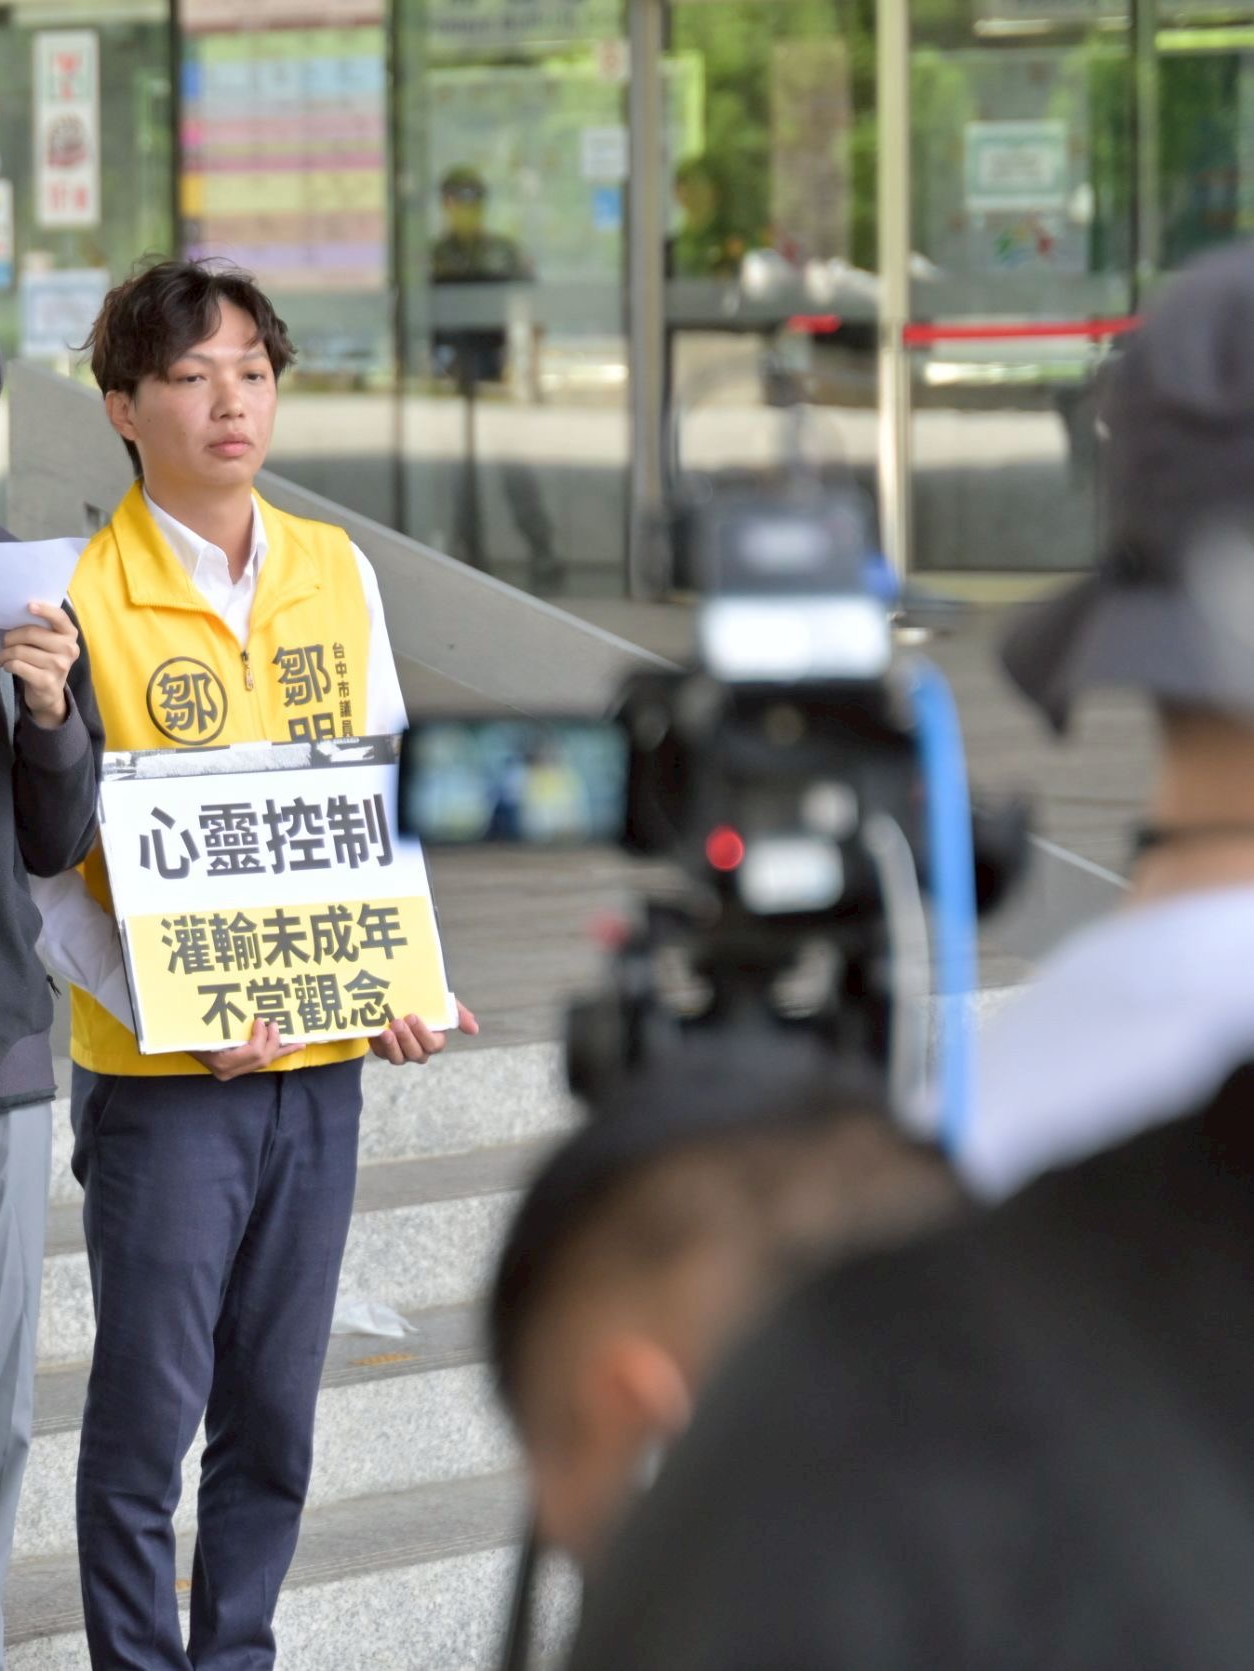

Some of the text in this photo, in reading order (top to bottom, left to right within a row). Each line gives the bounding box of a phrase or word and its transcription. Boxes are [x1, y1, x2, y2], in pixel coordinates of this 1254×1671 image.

[157, 672, 219, 735] 鄒
[332, 641, 354, 738] 台中市議員
[138, 793, 394, 881] 心靈控制
[159, 903, 408, 976] 灌輸未成年
[197, 968, 395, 1040] 不當觀念
